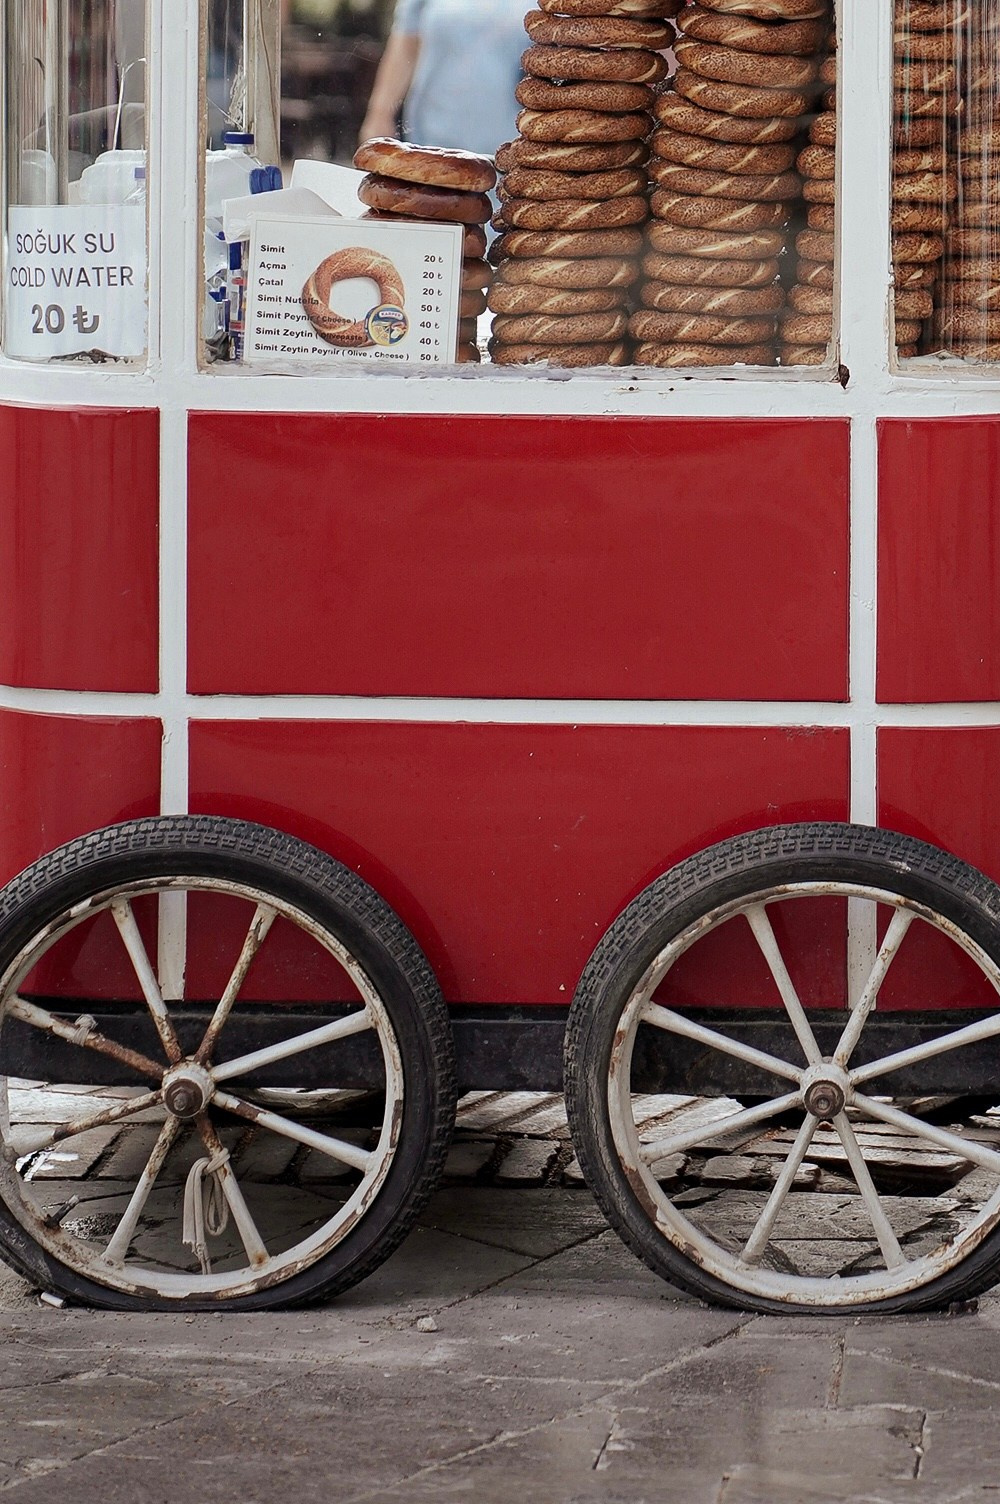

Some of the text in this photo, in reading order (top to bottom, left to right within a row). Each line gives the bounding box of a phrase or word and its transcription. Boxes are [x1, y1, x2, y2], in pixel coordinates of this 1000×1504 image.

[16, 228, 115, 254] SOĞUK SU
[260, 244, 285, 253] Simit
[424, 255, 436, 263] 20
[259, 261, 287, 270] Açma
[10, 266, 134, 288] COLD WATER
[423, 271, 434, 279] 20
[258, 277, 284, 287] Çatal
[422, 288, 434, 296] 20
[257, 294, 319, 305] Simit Nutella
[31, 304, 100, 334] 20 ₺
[256, 310, 282, 320] Simit
[419, 321, 432, 329] 40
[255, 327, 280, 336] Simit
[282, 328, 313, 339] Zeytin
[419, 337, 432, 345] 40
[254, 343, 278, 352] Simit
[280, 345, 309, 354] Zeytin
[347, 349, 367, 357] Olive
